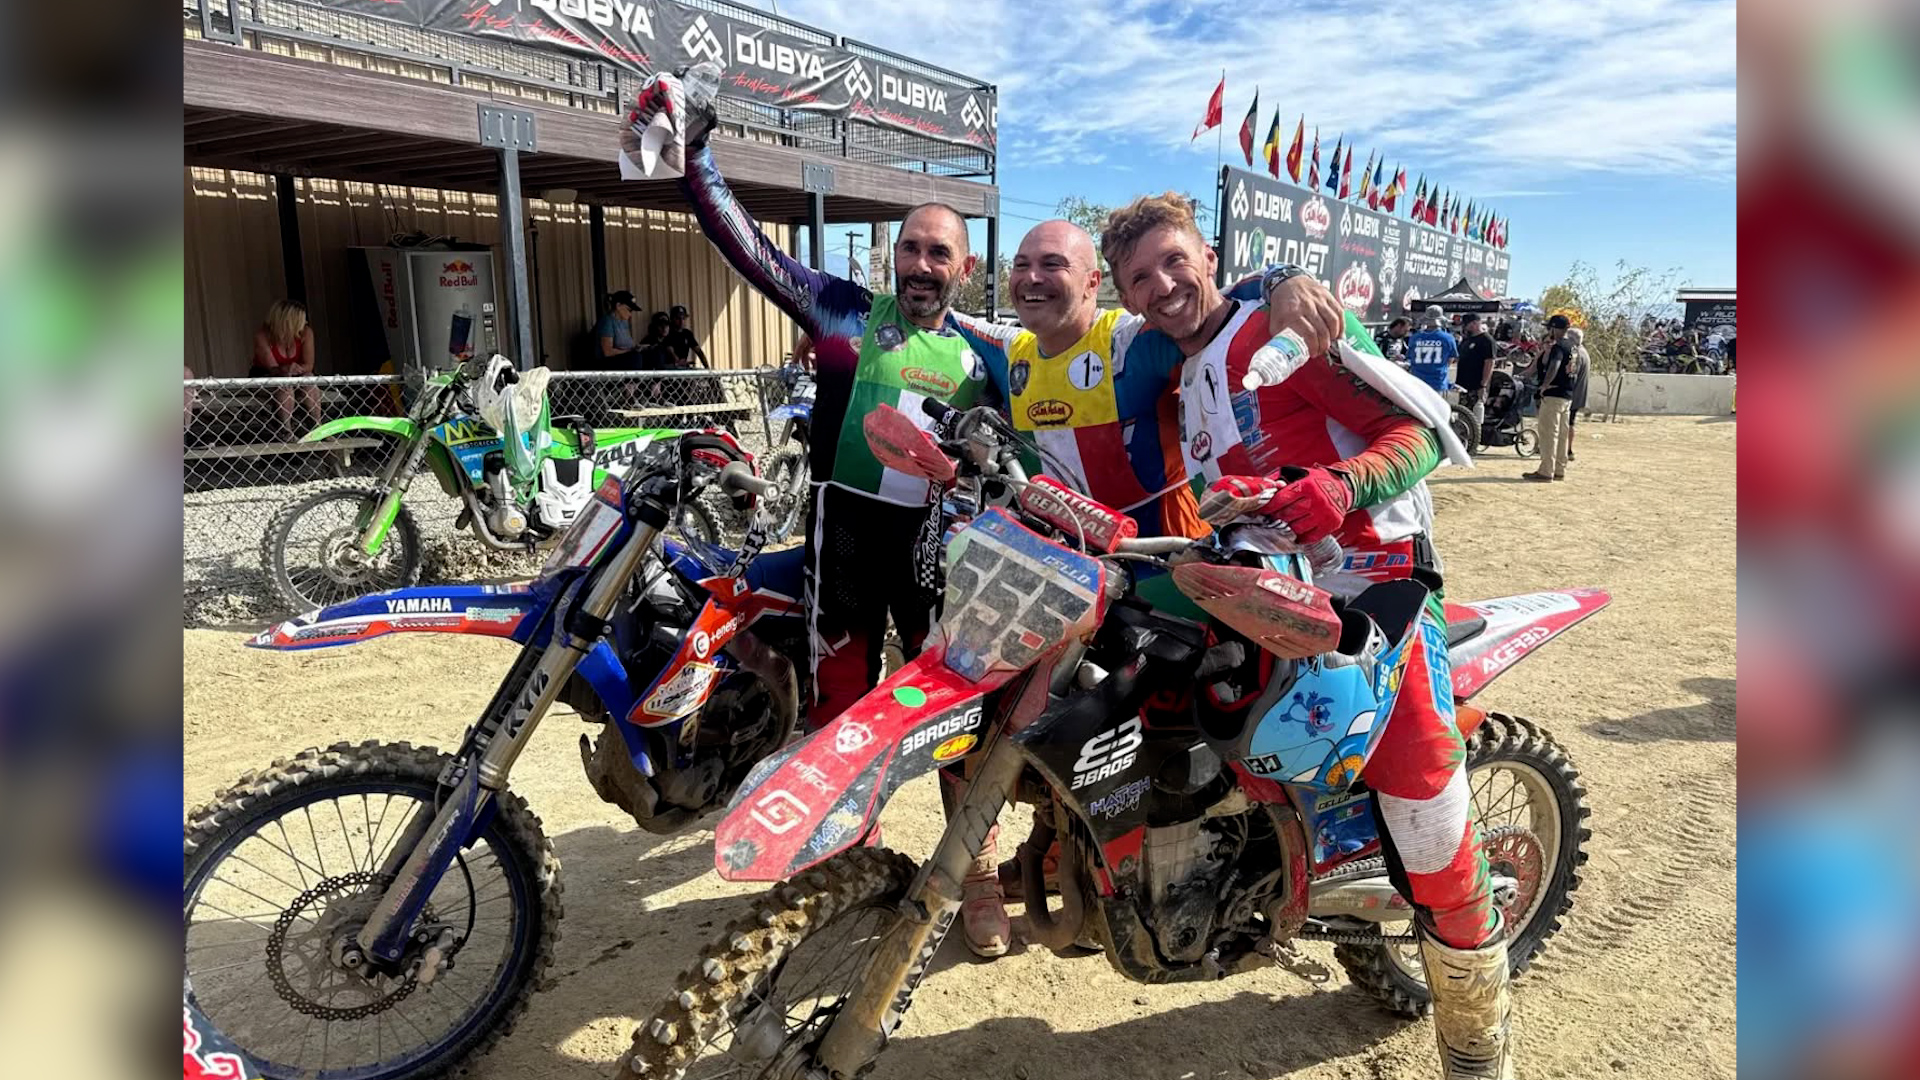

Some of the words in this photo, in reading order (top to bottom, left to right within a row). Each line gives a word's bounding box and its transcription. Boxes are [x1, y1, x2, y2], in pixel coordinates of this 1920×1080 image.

[736, 34, 823, 82] DUBYA
[882, 74, 947, 115] DUBYA
[1254, 190, 1292, 223] DUBYA
[1354, 213, 1379, 238] DUBYA
[1300, 241, 1329, 275] VET
[382, 262, 394, 294] Bull
[440, 277, 459, 287] Red
[460, 275, 477, 286] Bull
[386, 296, 398, 328] Red
[1083, 353, 1091, 387] 1
[1414, 347, 1441, 364] 171
[1042, 555, 1091, 583] CELLO
[386, 598, 452, 613] YAMAHA
[504, 668, 549, 739] KYB
[902, 716, 963, 757] 3BROS
[1071, 752, 1136, 790] 3BROS
[1090, 776, 1151, 815] HATCH
[1105, 791, 1141, 820] Racing
[1318, 795, 1351, 811] CELLO
[891, 909, 953, 1014] MAXXIS
